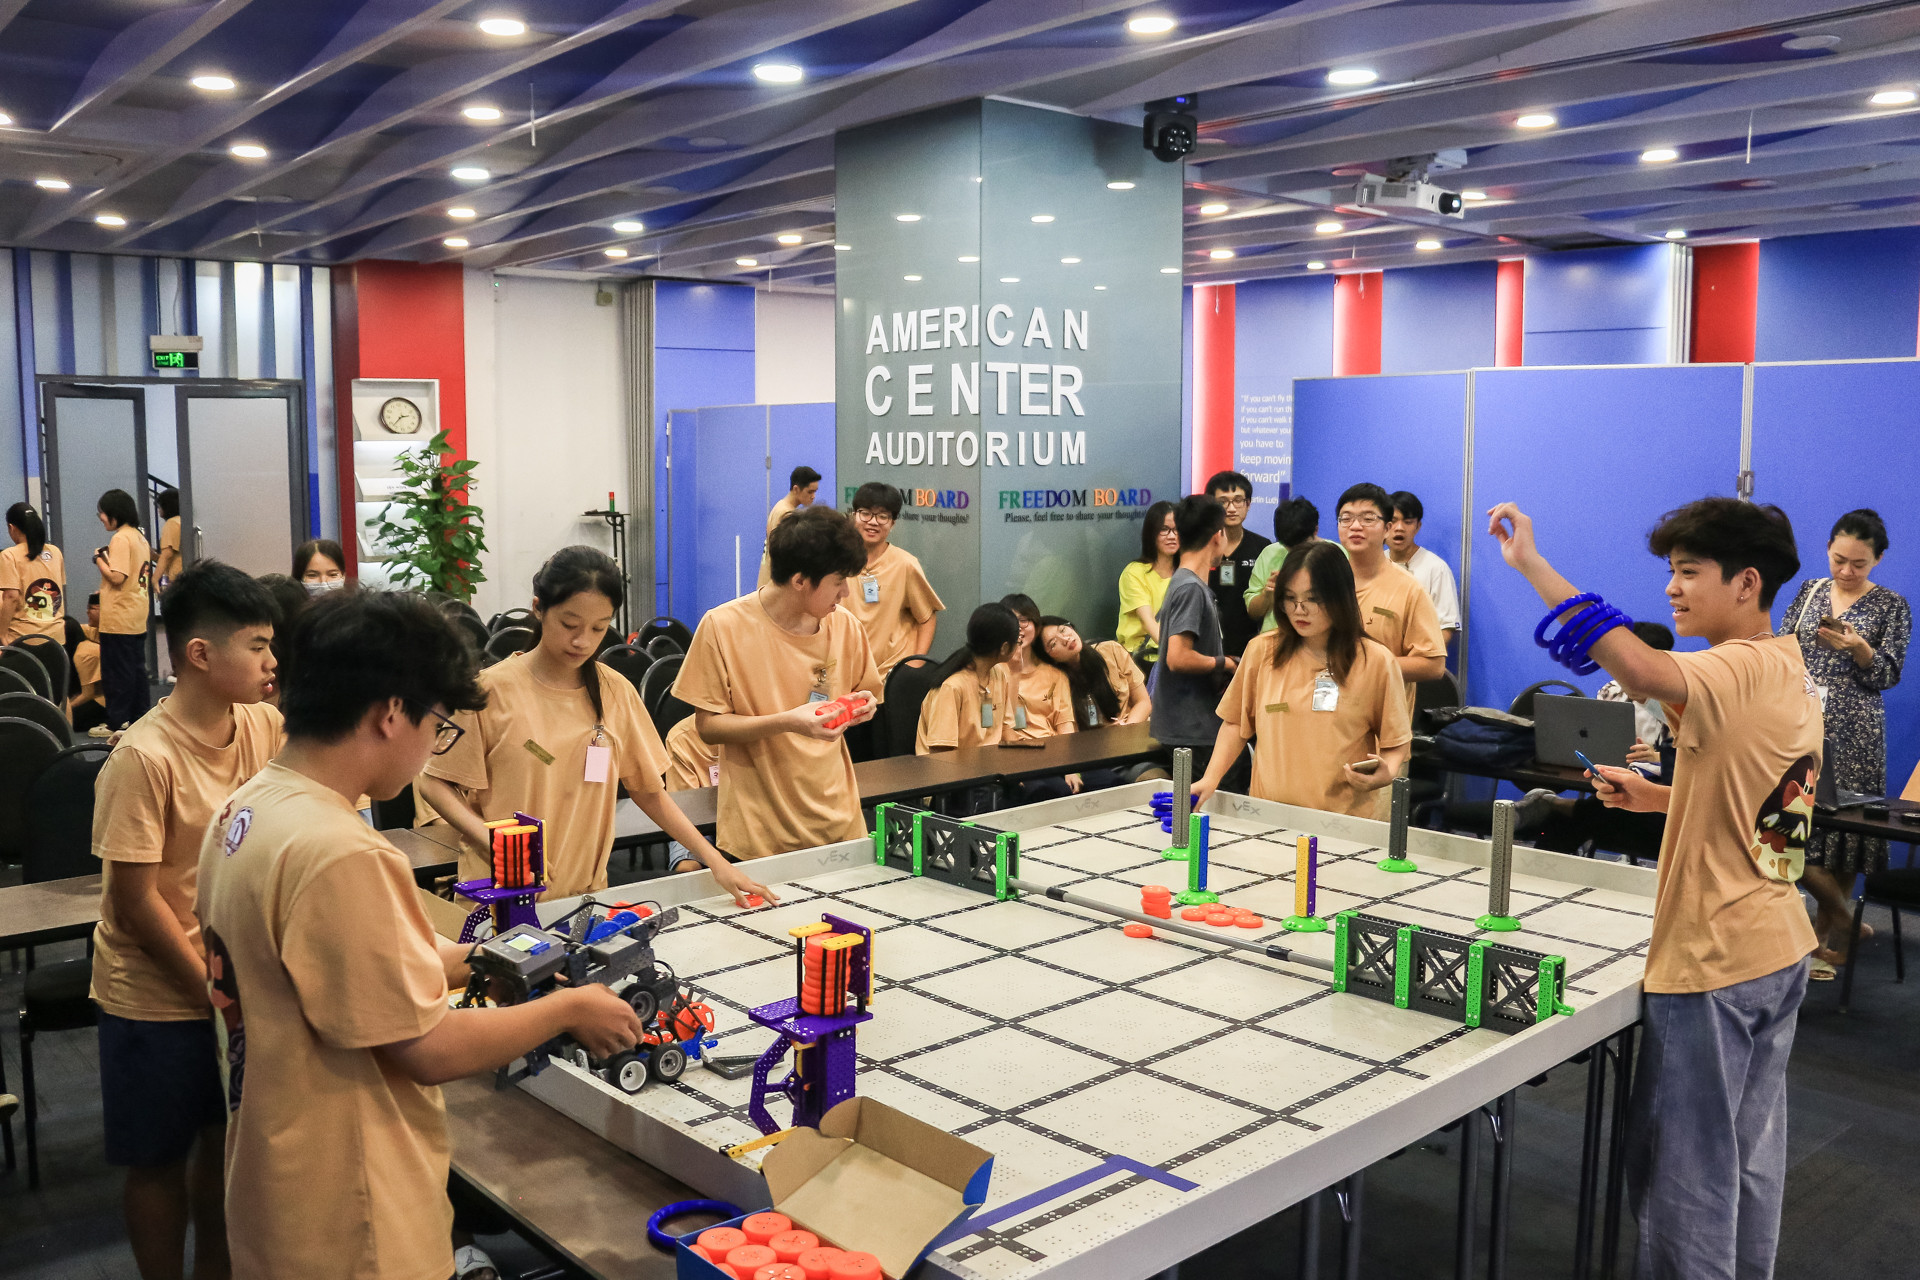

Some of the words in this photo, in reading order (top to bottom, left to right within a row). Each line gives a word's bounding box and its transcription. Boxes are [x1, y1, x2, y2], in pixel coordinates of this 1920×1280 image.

[865, 304, 1088, 354] AMERICAN
[865, 362, 1085, 416] CENTER
[1277, 394, 1285, 403] fly
[865, 430, 1086, 467] AUDITORIUM
[1240, 440, 1254, 449] you
[1255, 439, 1273, 448] have
[1275, 439, 1284, 448] to
[1240, 453, 1261, 466] keep
[1264, 454, 1291, 465] movin
[915, 488, 969, 509] BOARD
[998, 489, 1088, 509] FREEDOM
[1093, 487, 1153, 507] BOARD
[902, 510, 920, 521] share
[920, 513, 938, 524] your
[1004, 512, 1032, 523] Please,
[1033, 511, 1048, 522] feel
[1050, 511, 1064, 521] free
[1066, 512, 1074, 521] to
[1075, 510, 1094, 520] share
[1097, 511, 1113, 522] your
[1232, 801, 1261, 816] VEX
[816, 850, 850, 866] VEX
